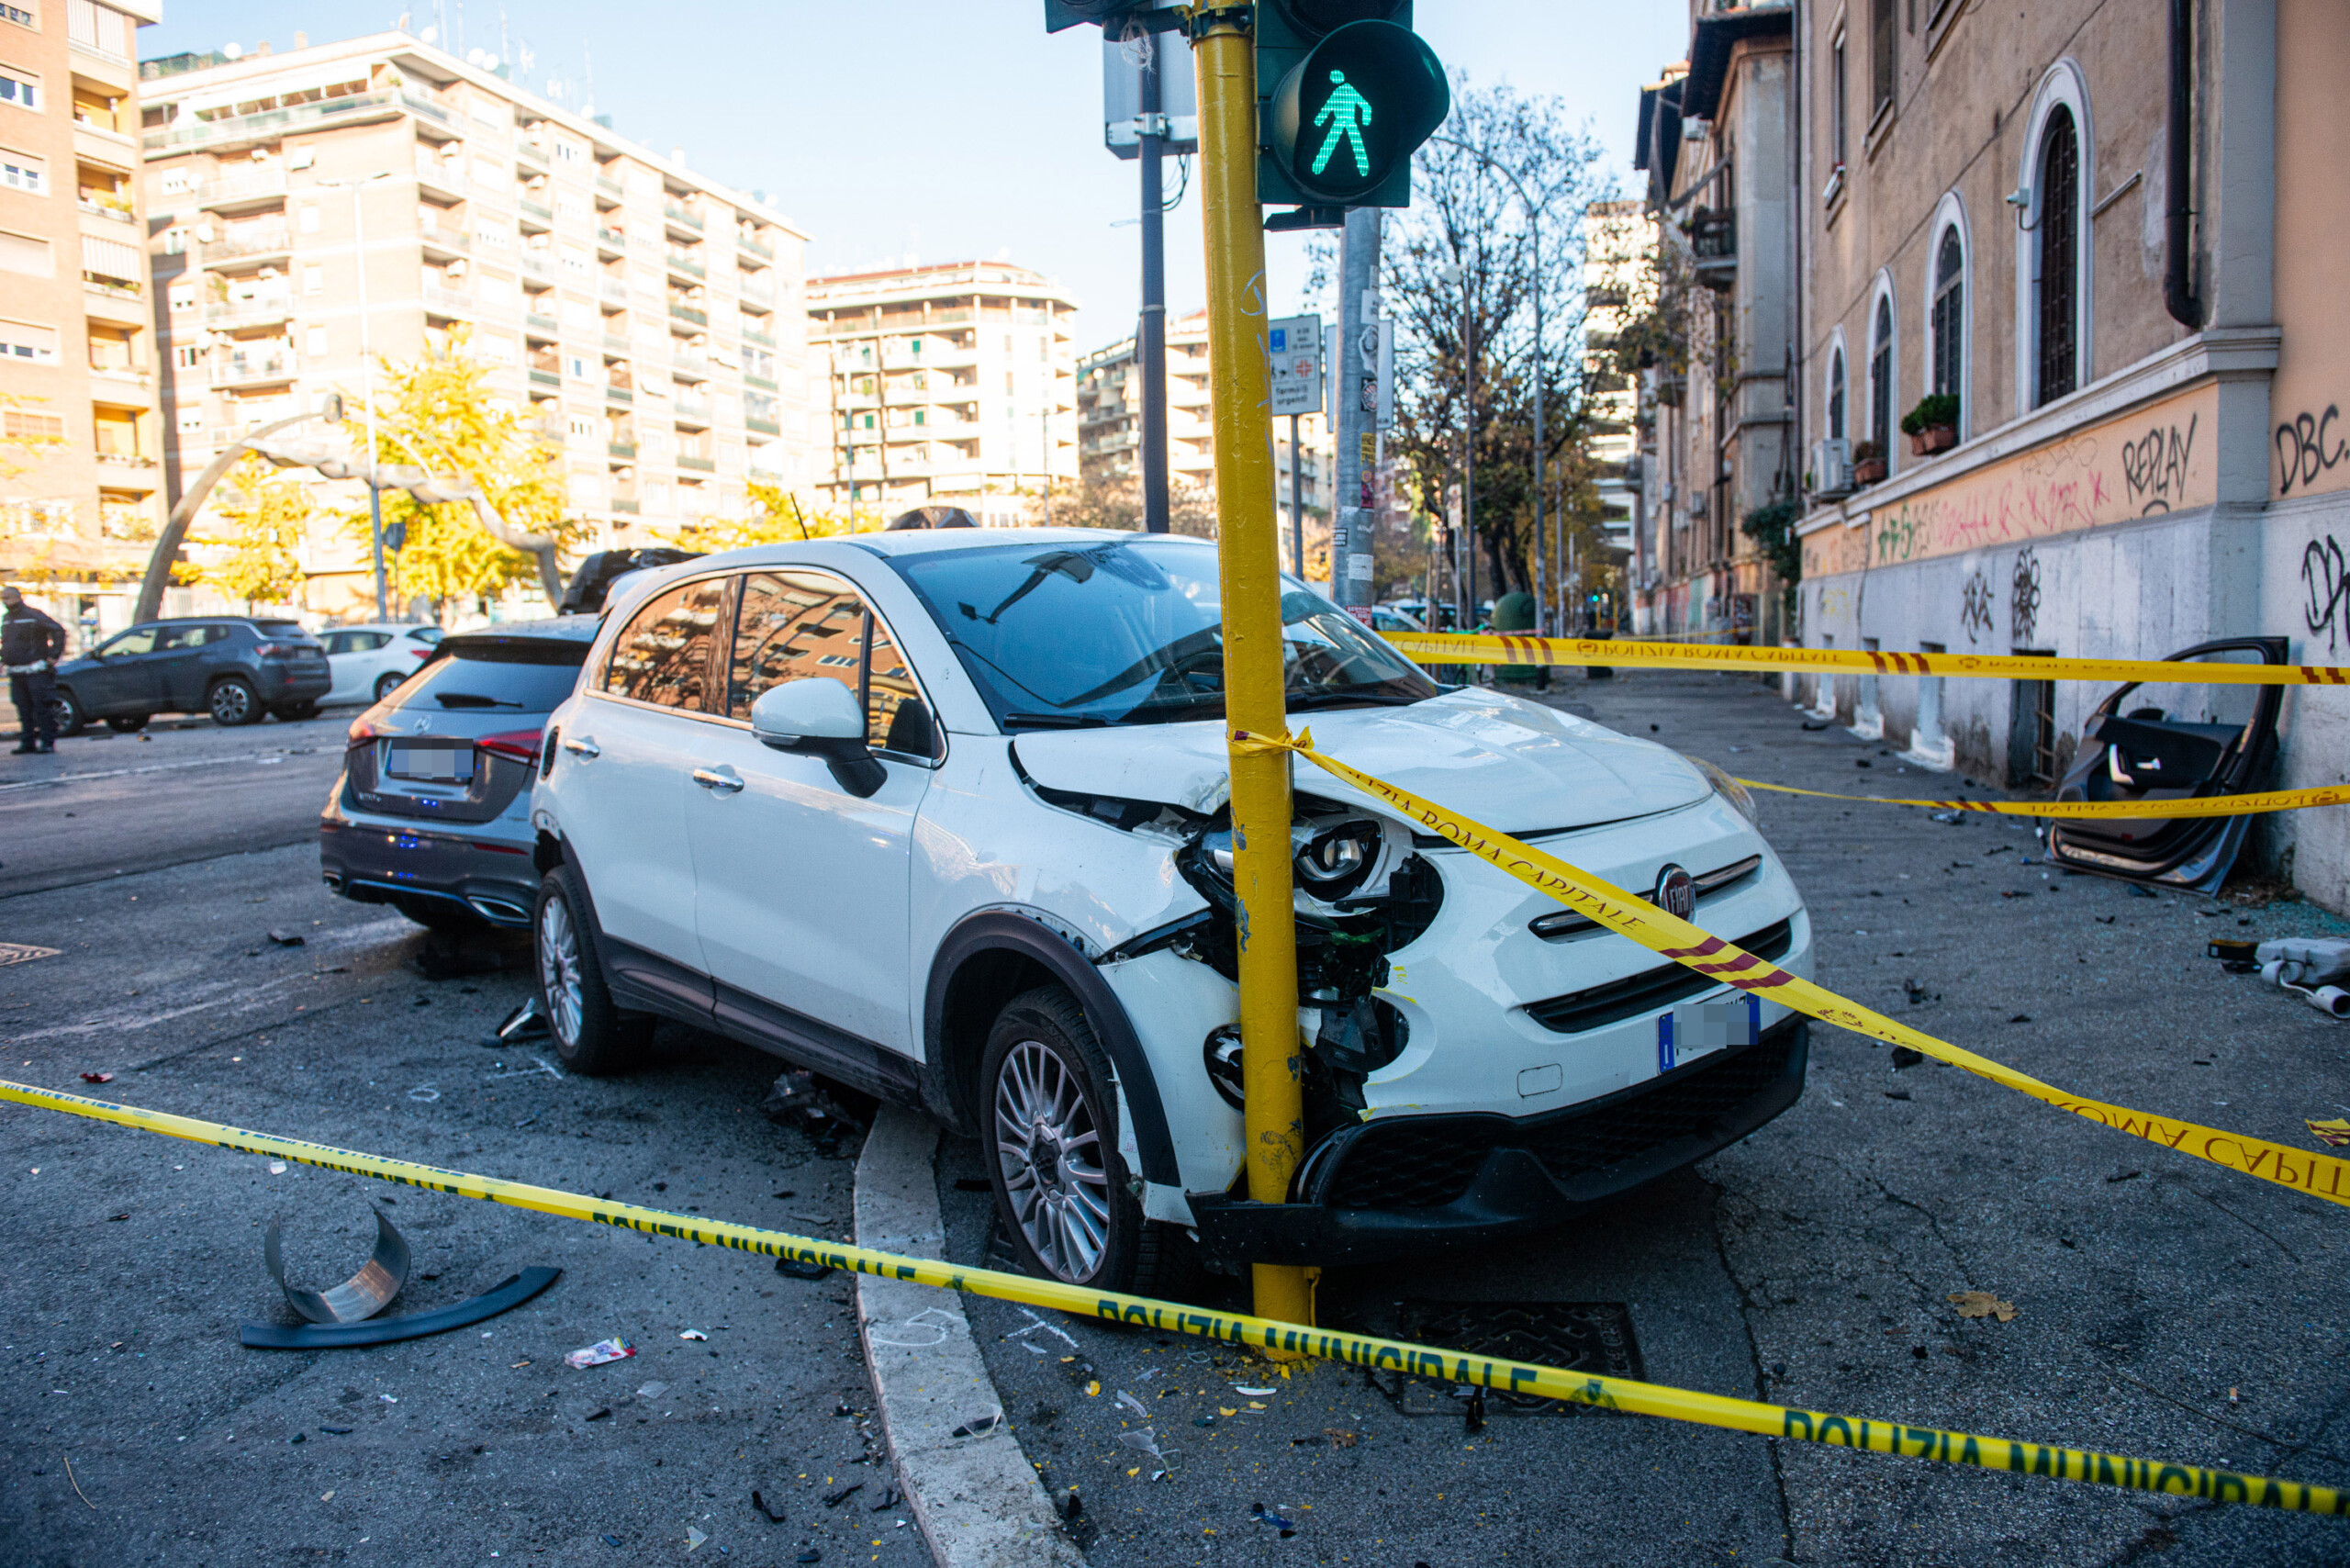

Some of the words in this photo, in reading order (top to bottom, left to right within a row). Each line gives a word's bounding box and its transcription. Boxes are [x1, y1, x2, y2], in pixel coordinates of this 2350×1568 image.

[2122, 412, 2198, 505] REPLAY
[1508, 860, 1646, 930] CAPITALE
[1670, 884, 1689, 914] FIAT
